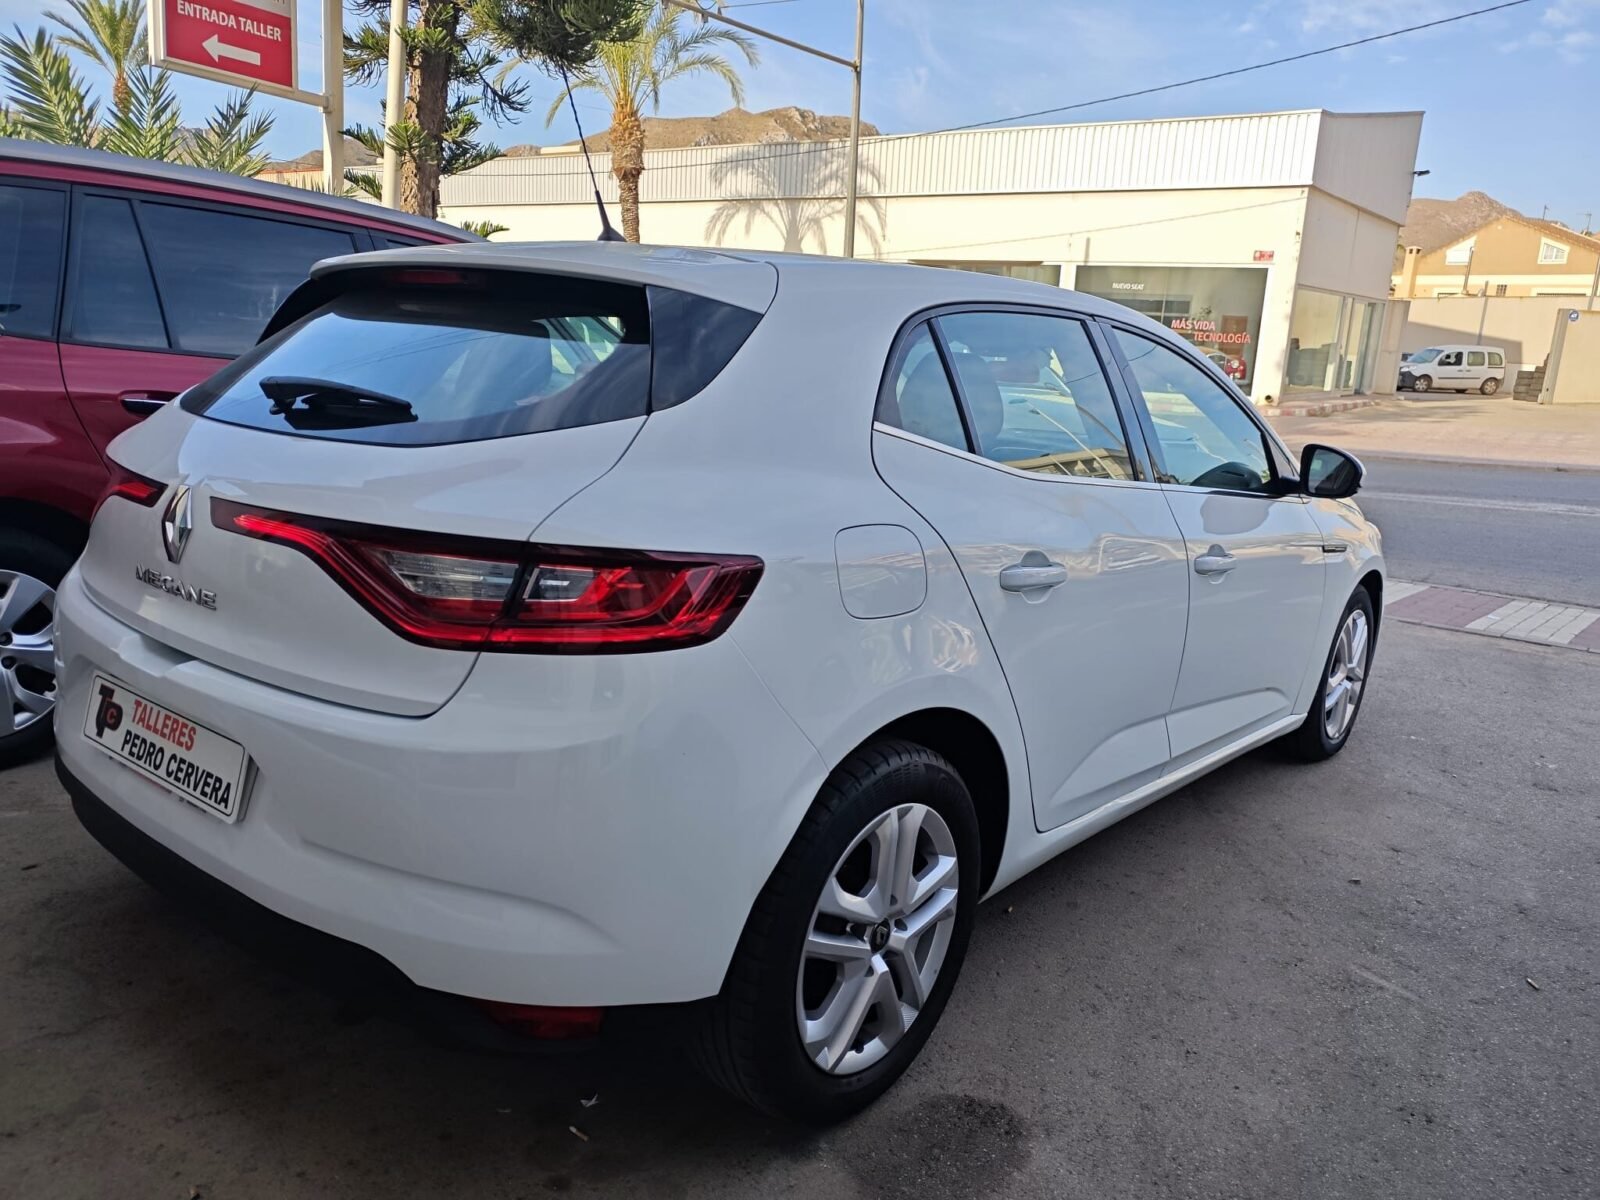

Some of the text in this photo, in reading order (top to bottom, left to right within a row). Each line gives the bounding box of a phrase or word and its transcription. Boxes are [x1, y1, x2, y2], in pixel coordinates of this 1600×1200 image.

[177, 0, 282, 41] ENTRADA TALLER
[1112, 282, 1144, 291] NUEVO SEAT
[1171, 318, 1216, 331] MÁS VIDA
[1193, 331, 1251, 344] TECNOLOGÍA
[136, 561, 217, 611] MEGANE
[131, 699, 197, 752] TALLERES
[121, 729, 232, 809] PEDRO CERVERA
